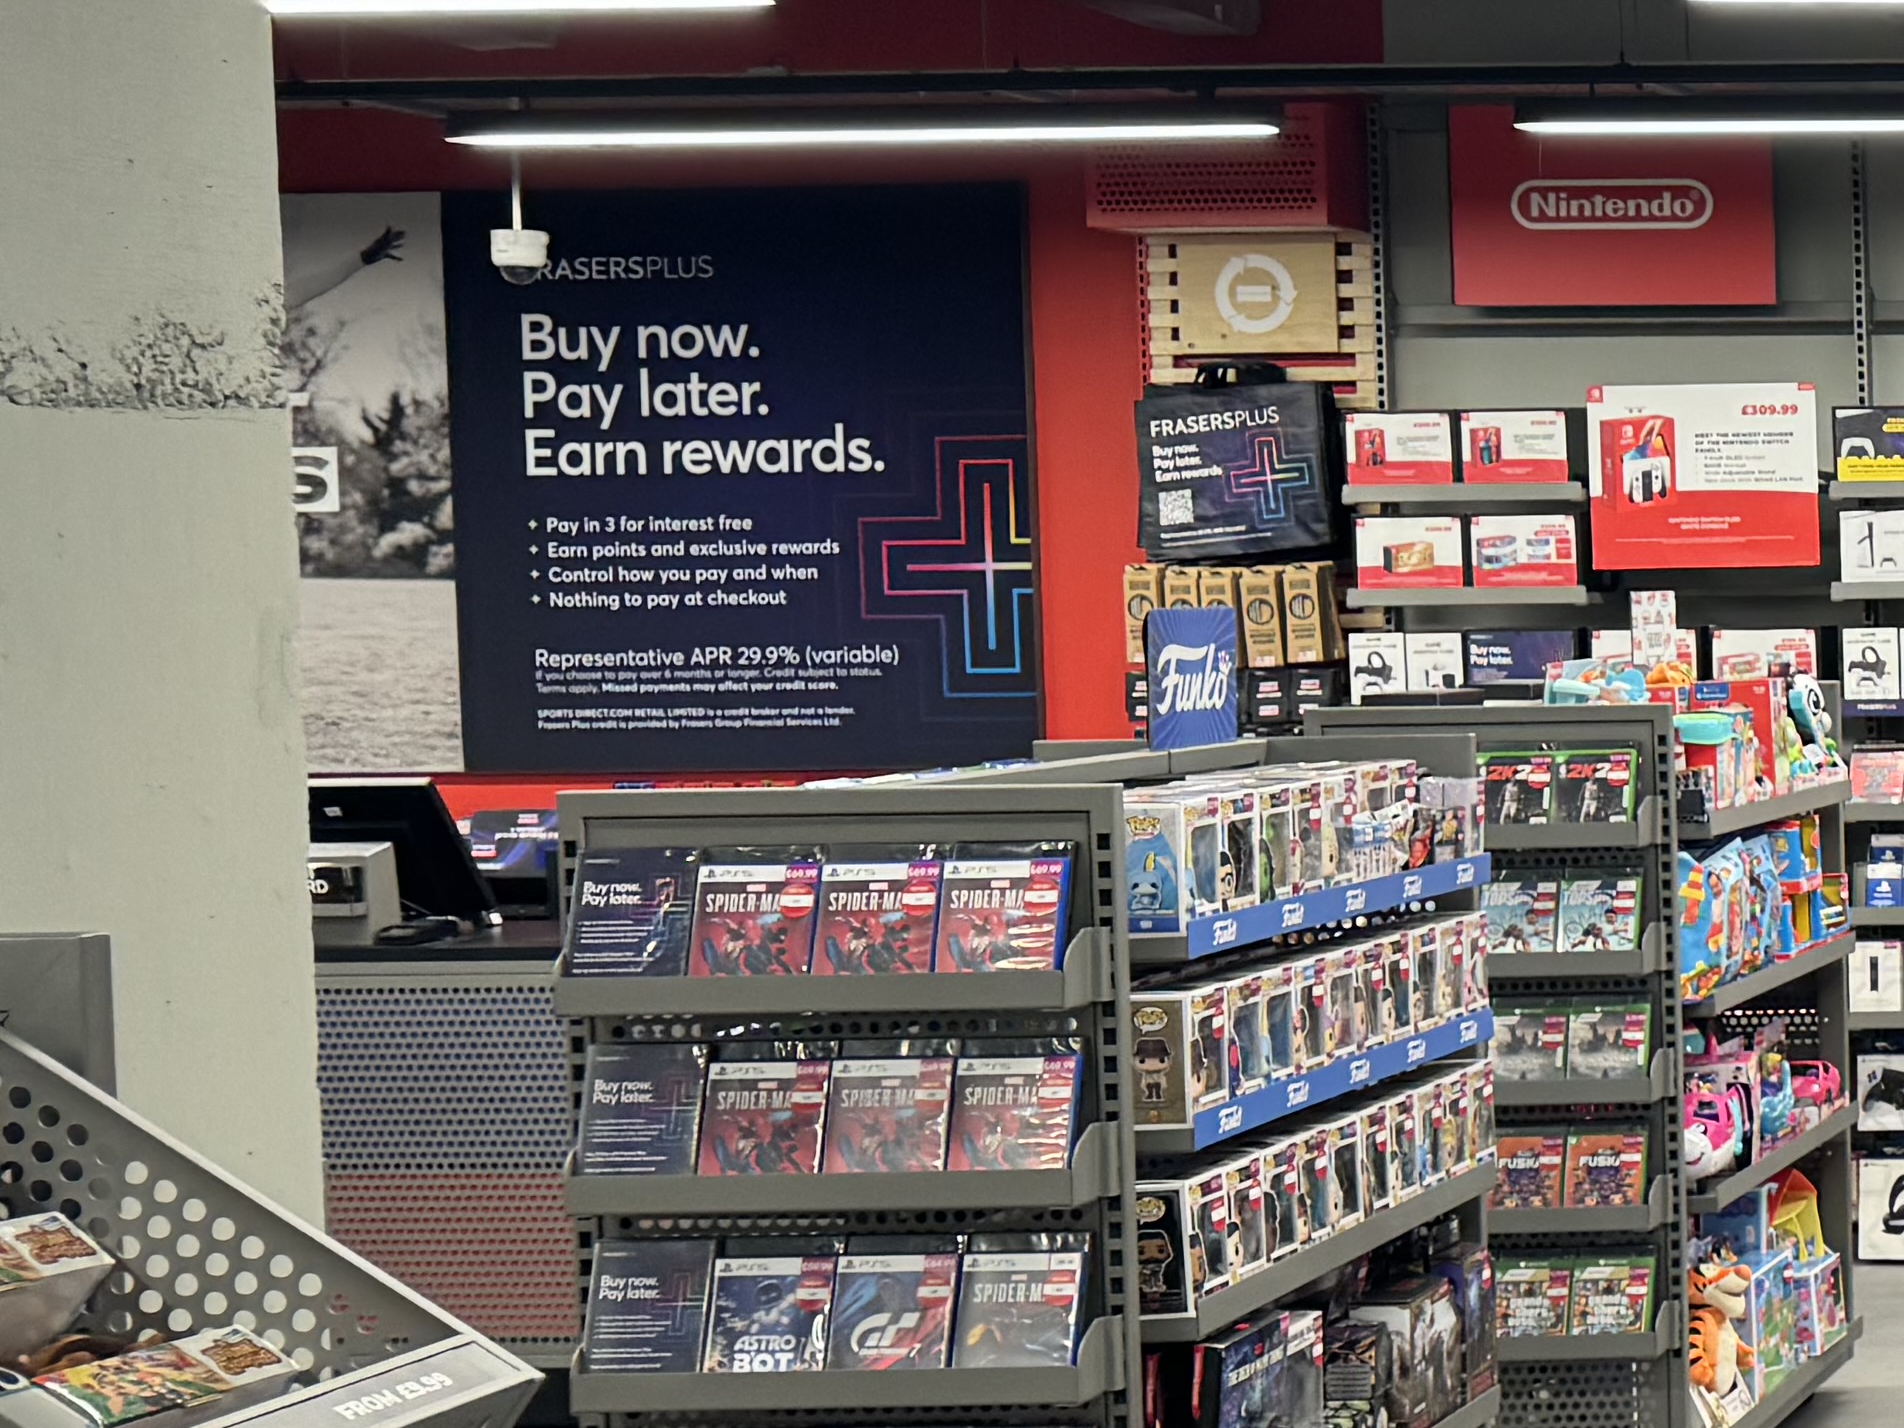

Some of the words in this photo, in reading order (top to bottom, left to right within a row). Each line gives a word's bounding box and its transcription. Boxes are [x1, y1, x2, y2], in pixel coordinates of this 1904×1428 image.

[1528, 190, 1698, 220] Nintendo
[536, 255, 714, 280] RASERSPLUS
[521, 313, 620, 371] Buy
[637, 324, 760, 359] now.
[523, 371, 623, 430] Pay
[640, 367, 769, 417] later.
[1150, 406, 1280, 438] FRASERSPLUS
[525, 429, 647, 476] Earn
[663, 423, 885, 475] rewards.
[546, 517, 579, 535] Pay
[583, 517, 600, 533] in
[604, 517, 615, 533] 3
[620, 516, 644, 532] for
[648, 515, 714, 532] interest
[719, 514, 753, 531] free
[547, 541, 587, 557] Earn
[592, 541, 646, 560] points
[651, 540, 684, 556] and
[689, 540, 767, 556] exclusive
[771, 539, 840, 555] rewards
[548, 566, 613, 583] Control
[618, 566, 655, 582] how
[659, 569, 691, 585] you
[695, 568, 728, 584] pay
[732, 565, 766, 580] and
[771, 564, 819, 580] when
[549, 592, 620, 610] Nothing
[624, 593, 642, 608] to
[647, 594, 680, 610] pay
[684, 592, 703, 606] at
[707, 590, 788, 605] checkout
[535, 648, 684, 670] Representative
[690, 647, 732, 665] APR
[737, 646, 800, 665] 29.9%
[805, 644, 900, 665] (variable)
[1156, 643, 1233, 716] Funko
[733, 1336, 797, 1352] ASTRO
[733, 1352, 796, 1373] BOT
